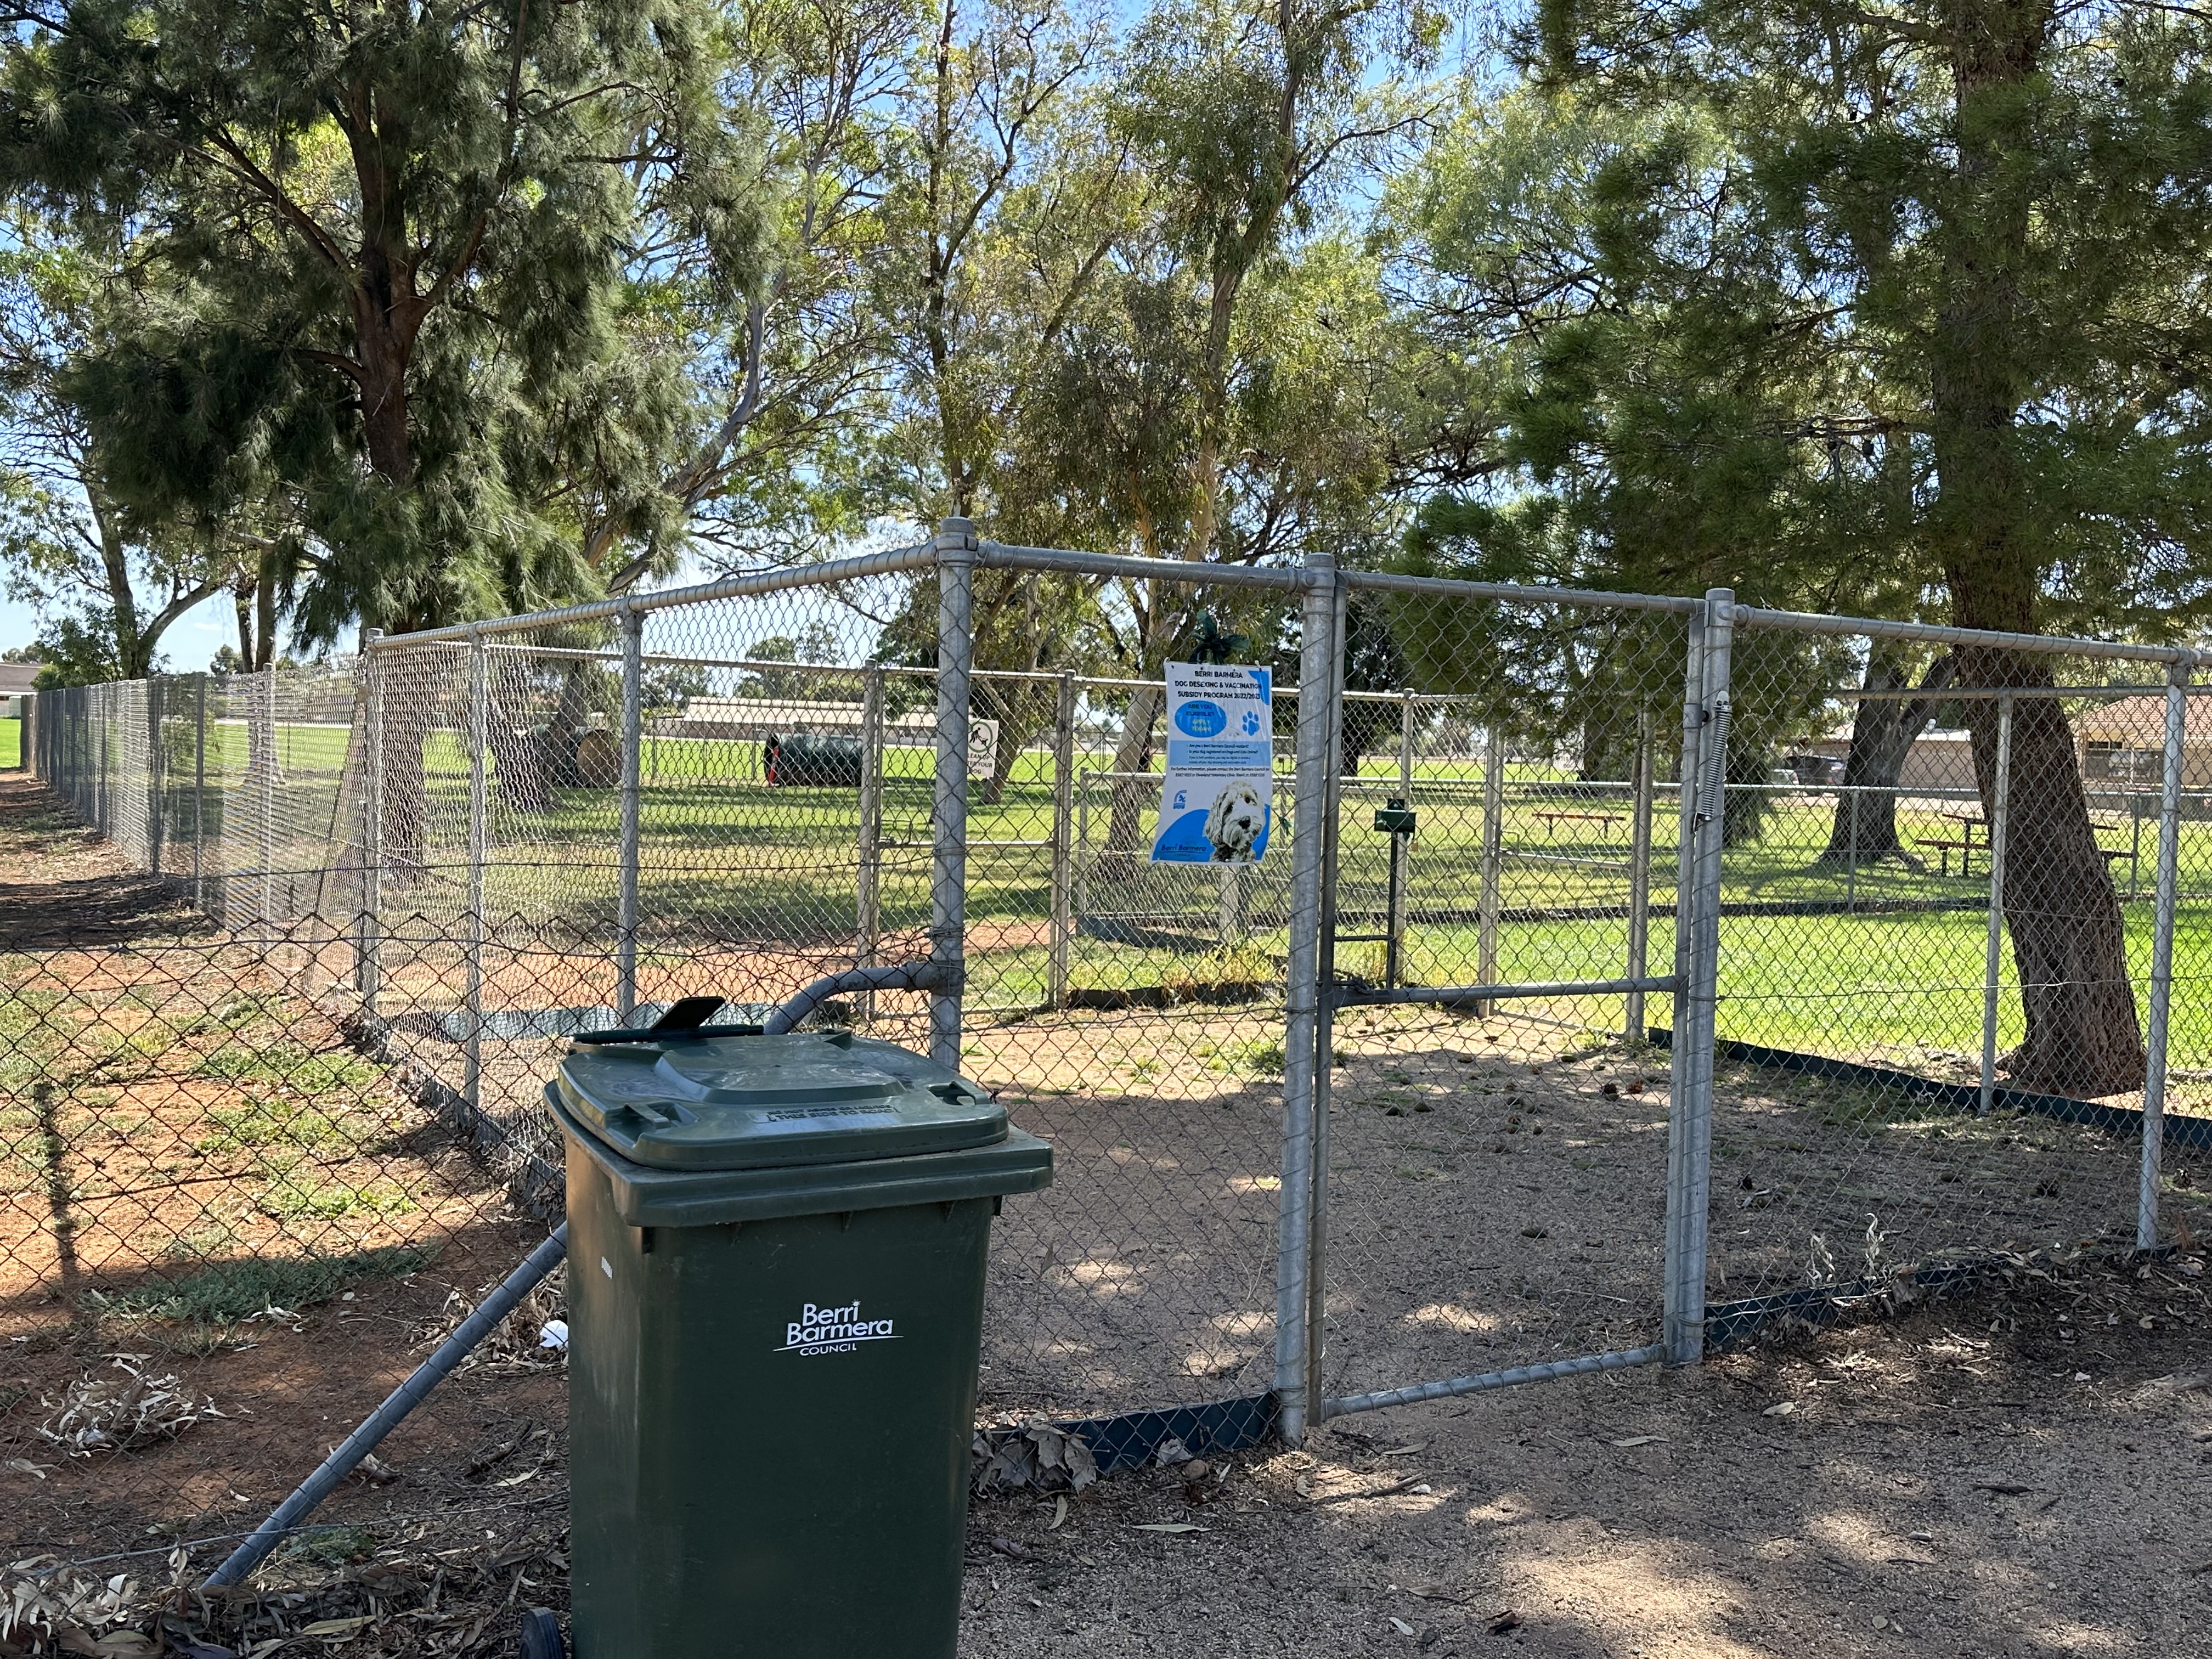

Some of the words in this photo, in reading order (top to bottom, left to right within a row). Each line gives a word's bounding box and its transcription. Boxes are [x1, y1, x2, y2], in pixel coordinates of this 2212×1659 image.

[1161, 843, 1178, 851] Berri
[1178, 844, 1207, 852] Barmera
[802, 1299, 861, 1327] Berri
[786, 1319, 893, 1346] Barmera
[799, 1342, 857, 1356] COUNCIL
